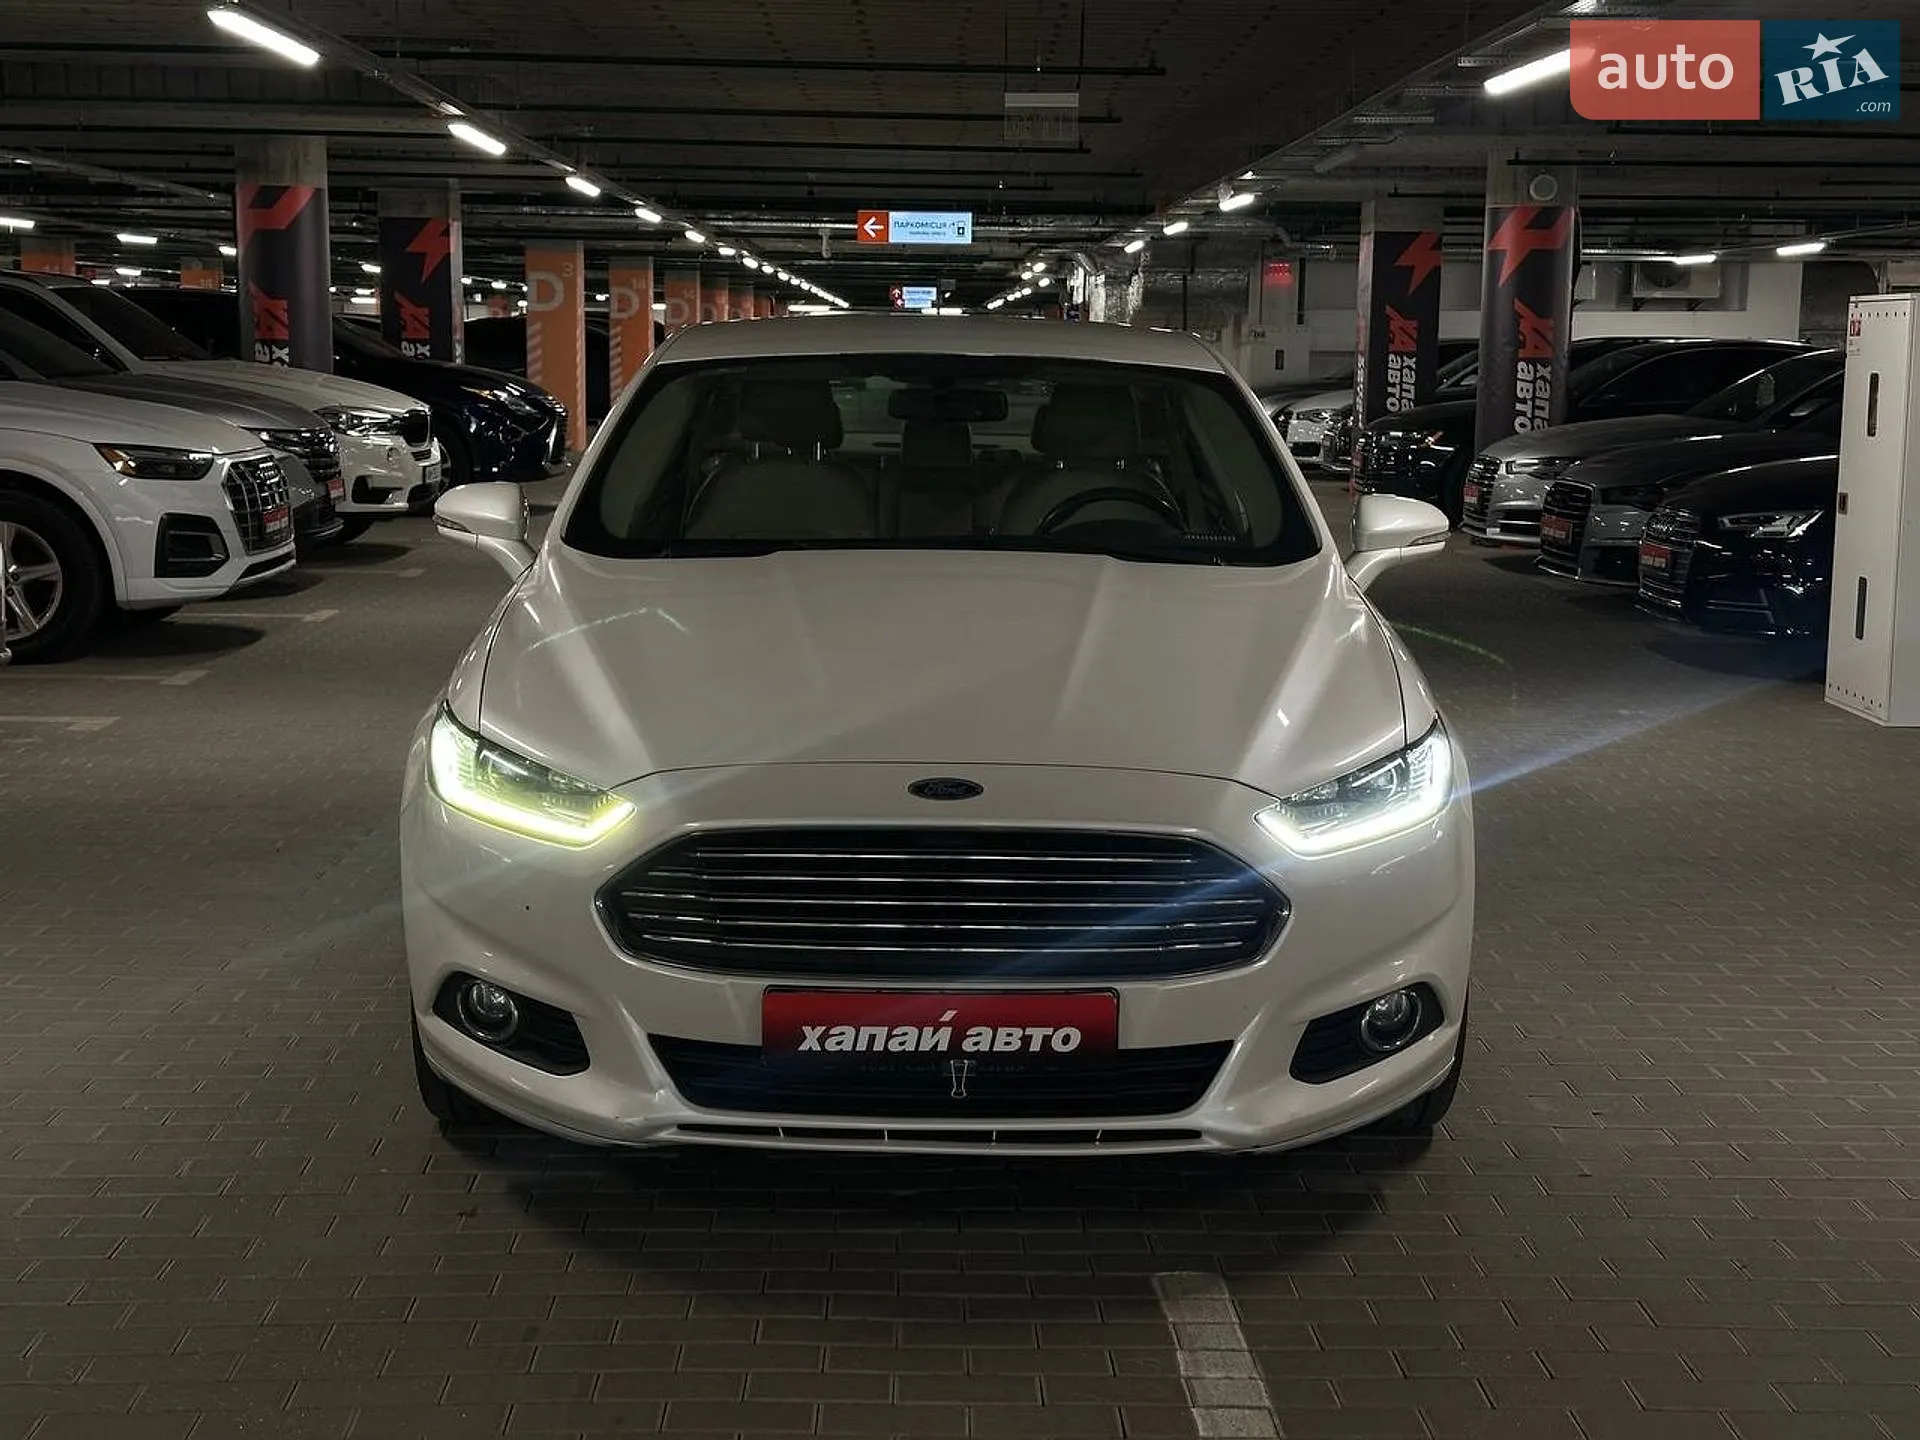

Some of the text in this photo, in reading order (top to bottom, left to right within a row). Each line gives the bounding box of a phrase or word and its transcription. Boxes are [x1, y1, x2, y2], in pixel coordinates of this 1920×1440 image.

[1386, 353, 1401, 412] авто
[1513, 360, 1535, 434] авто
[798, 1010, 1082, 1052] хапай авто
